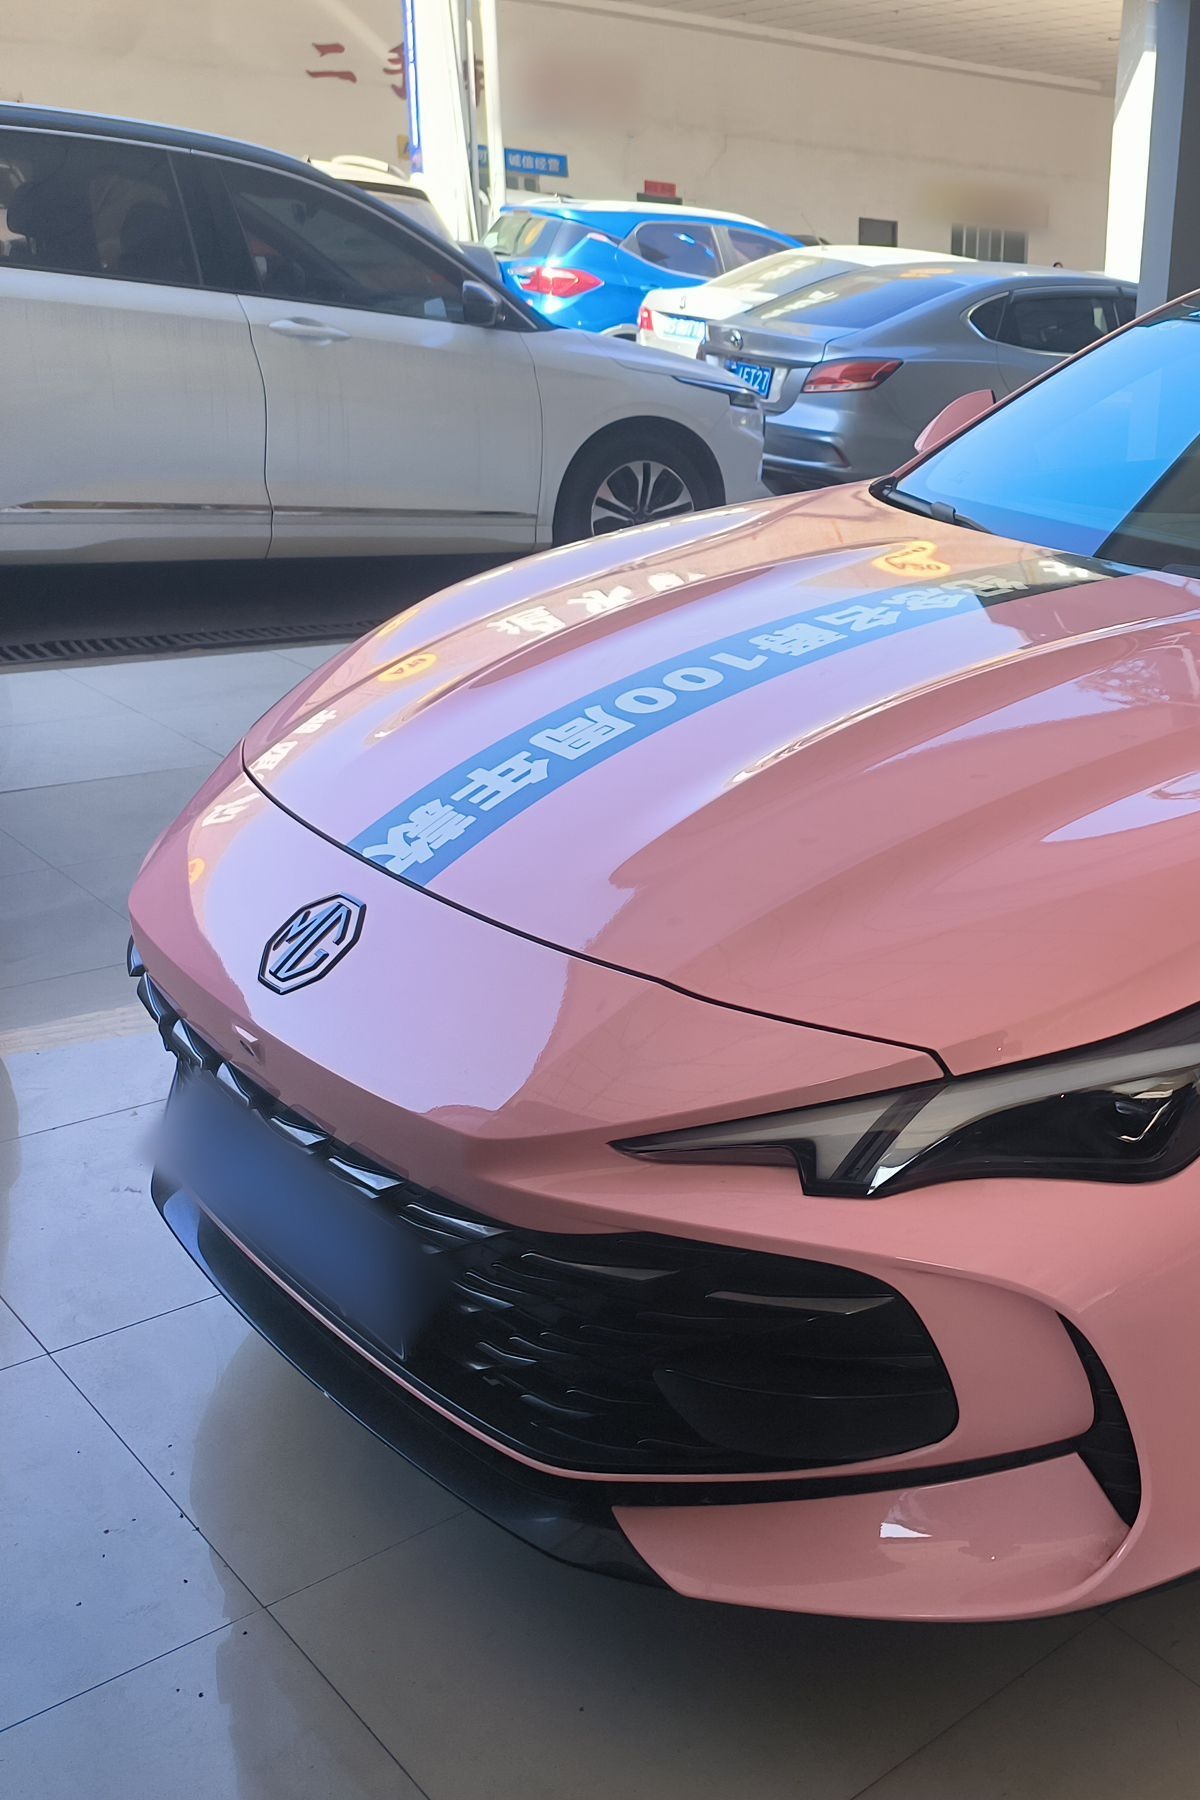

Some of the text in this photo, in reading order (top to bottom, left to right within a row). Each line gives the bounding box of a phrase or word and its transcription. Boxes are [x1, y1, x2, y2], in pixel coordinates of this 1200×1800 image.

[362, 574, 1030, 875] 纪念名爵100周年款
[268, 901, 352, 982] MG
